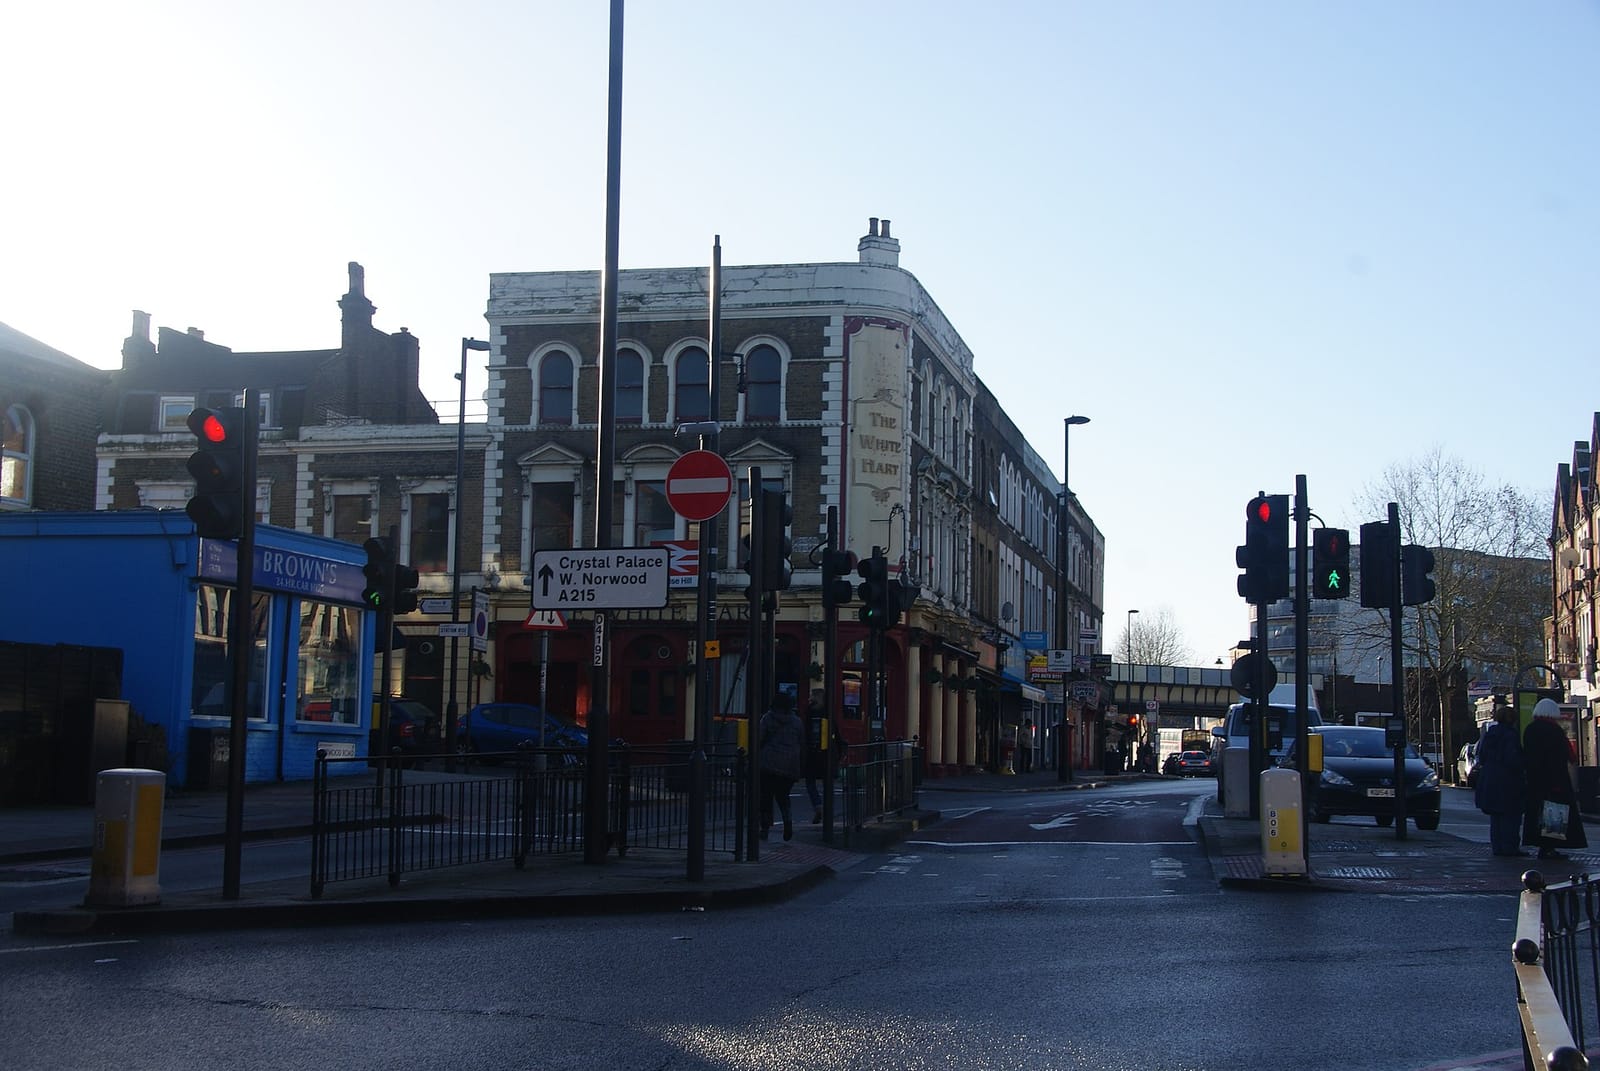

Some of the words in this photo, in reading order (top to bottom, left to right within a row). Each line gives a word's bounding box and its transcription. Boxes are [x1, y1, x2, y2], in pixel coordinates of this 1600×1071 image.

[869, 412, 897, 429] THE
[860, 434, 901, 453] WHITE
[862, 459, 899, 475] HART
[263, 551, 337, 584] BROWN'S
[559, 556, 610, 571] Crystal
[616, 555, 663, 568] Palace
[559, 573, 577, 585] W.
[582, 572, 647, 585] Norwood
[559, 589, 595, 601] A215
